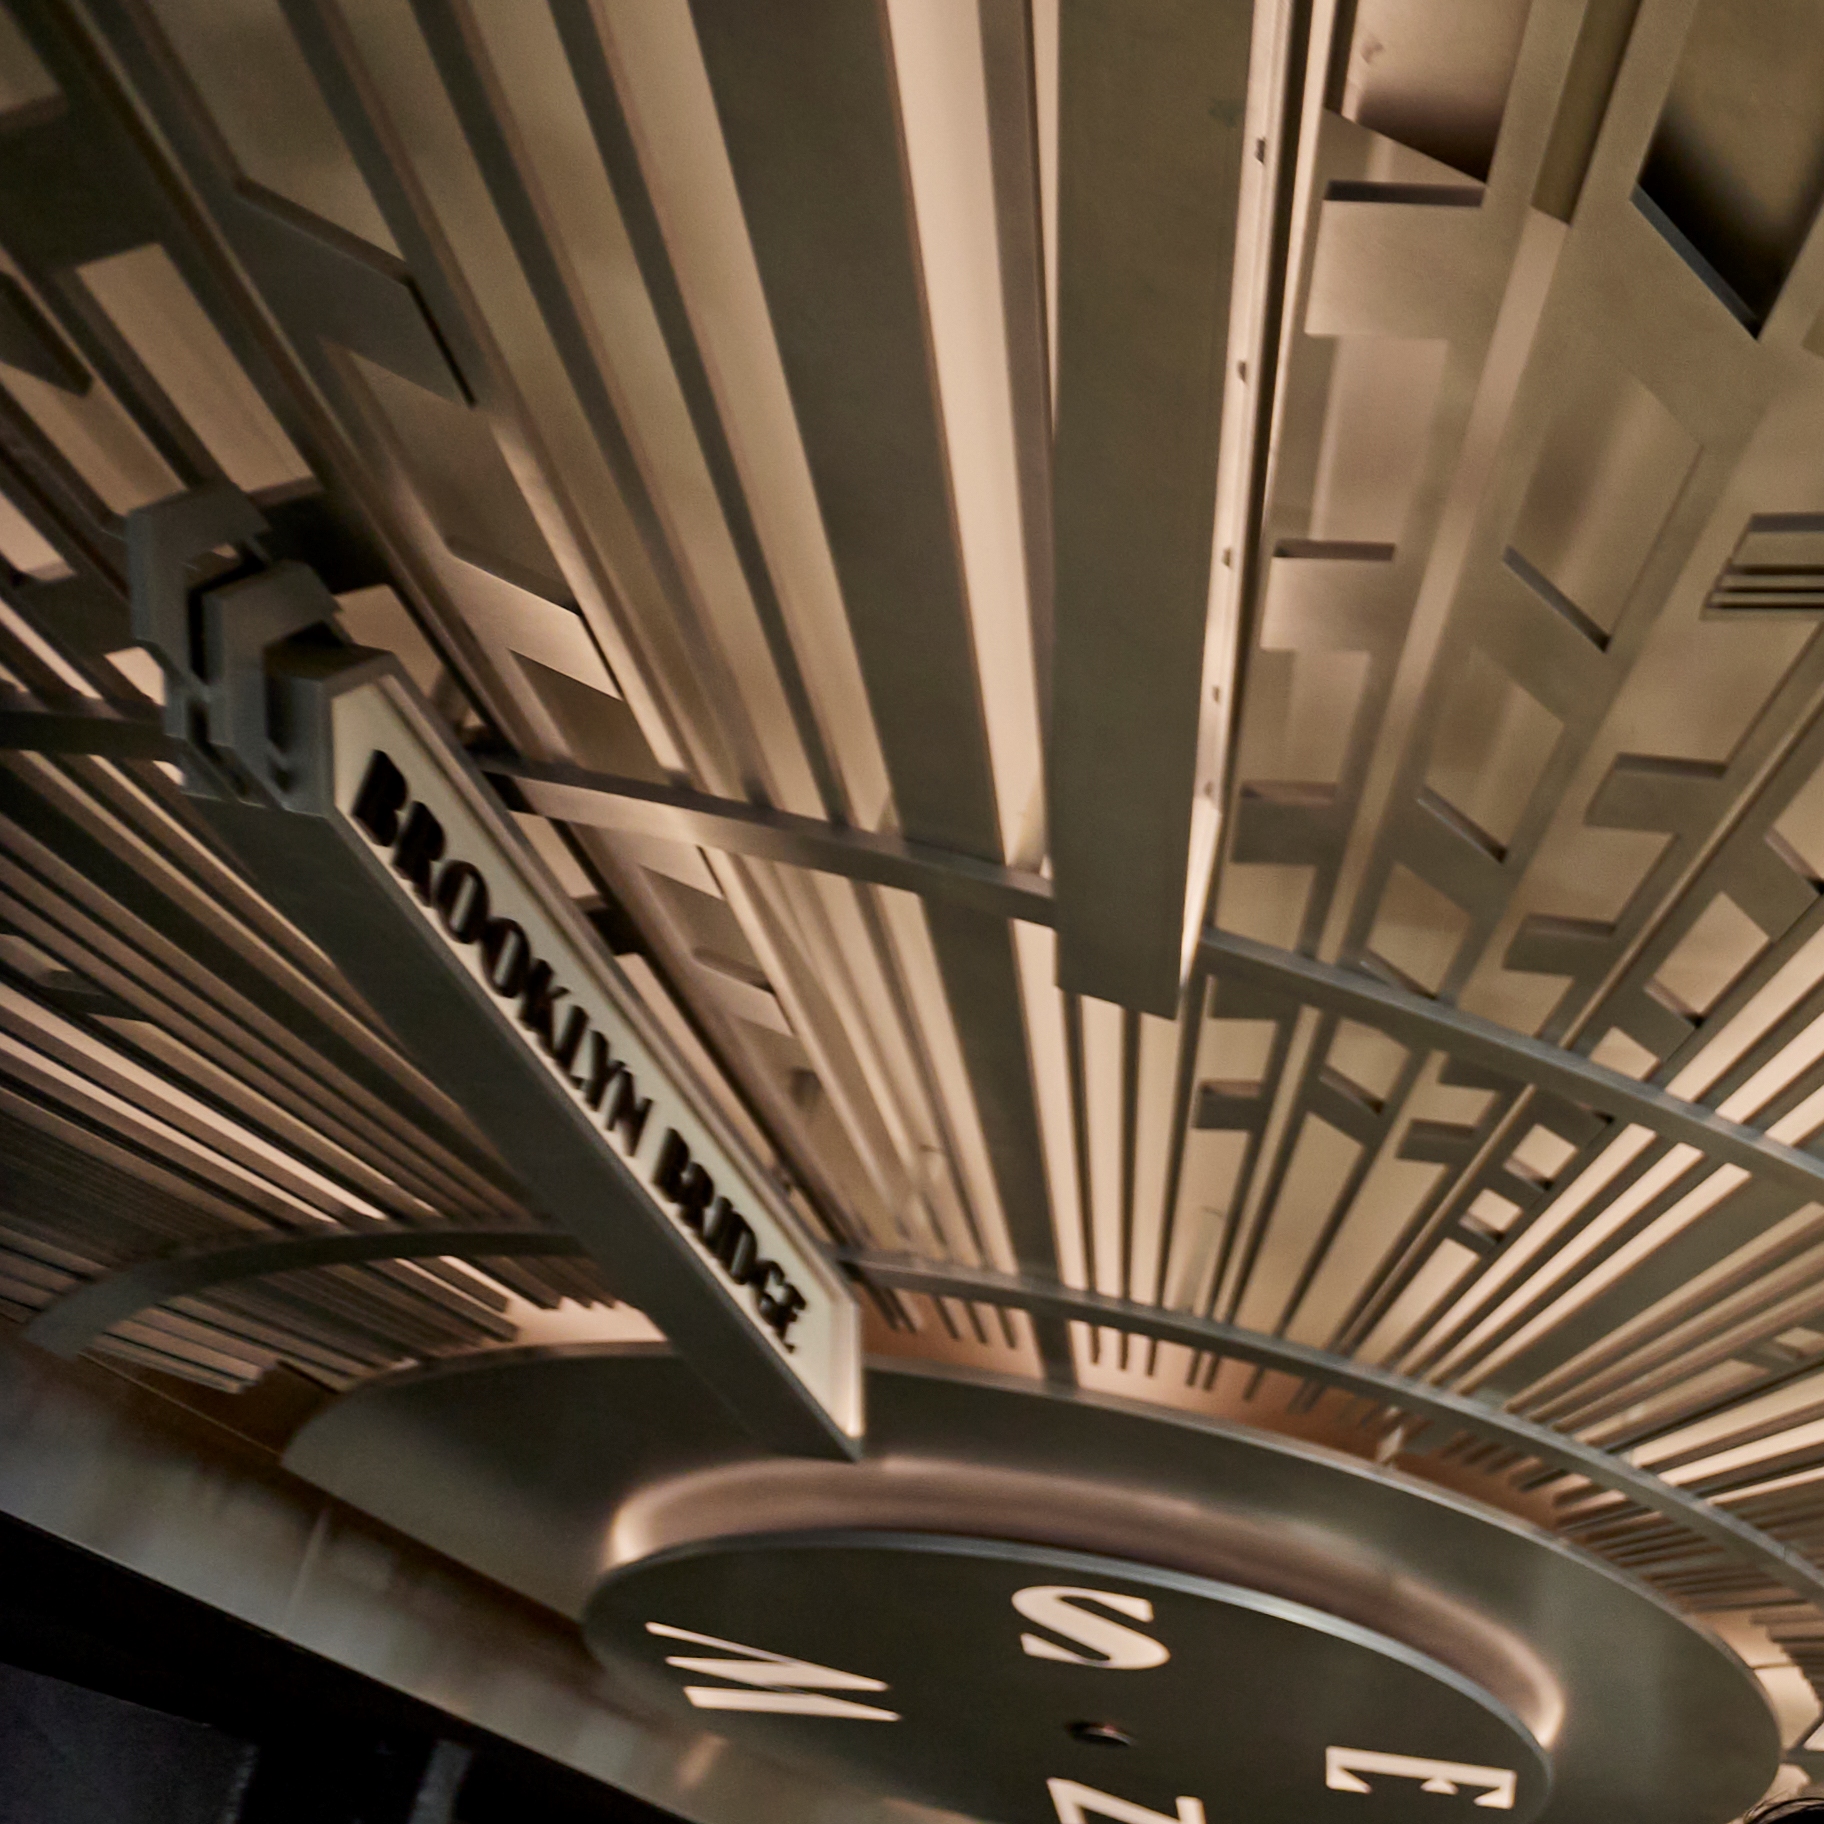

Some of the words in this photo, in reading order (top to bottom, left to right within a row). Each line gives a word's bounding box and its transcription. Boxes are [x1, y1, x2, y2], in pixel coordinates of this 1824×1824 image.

[353, 749, 655, 1157] BROOKLYN
[654, 1126, 808, 1354] BRIDGE
[645, 1621, 902, 1721] W
[1012, 1585, 1170, 1670] S
[1325, 1745, 1516, 1809] E
